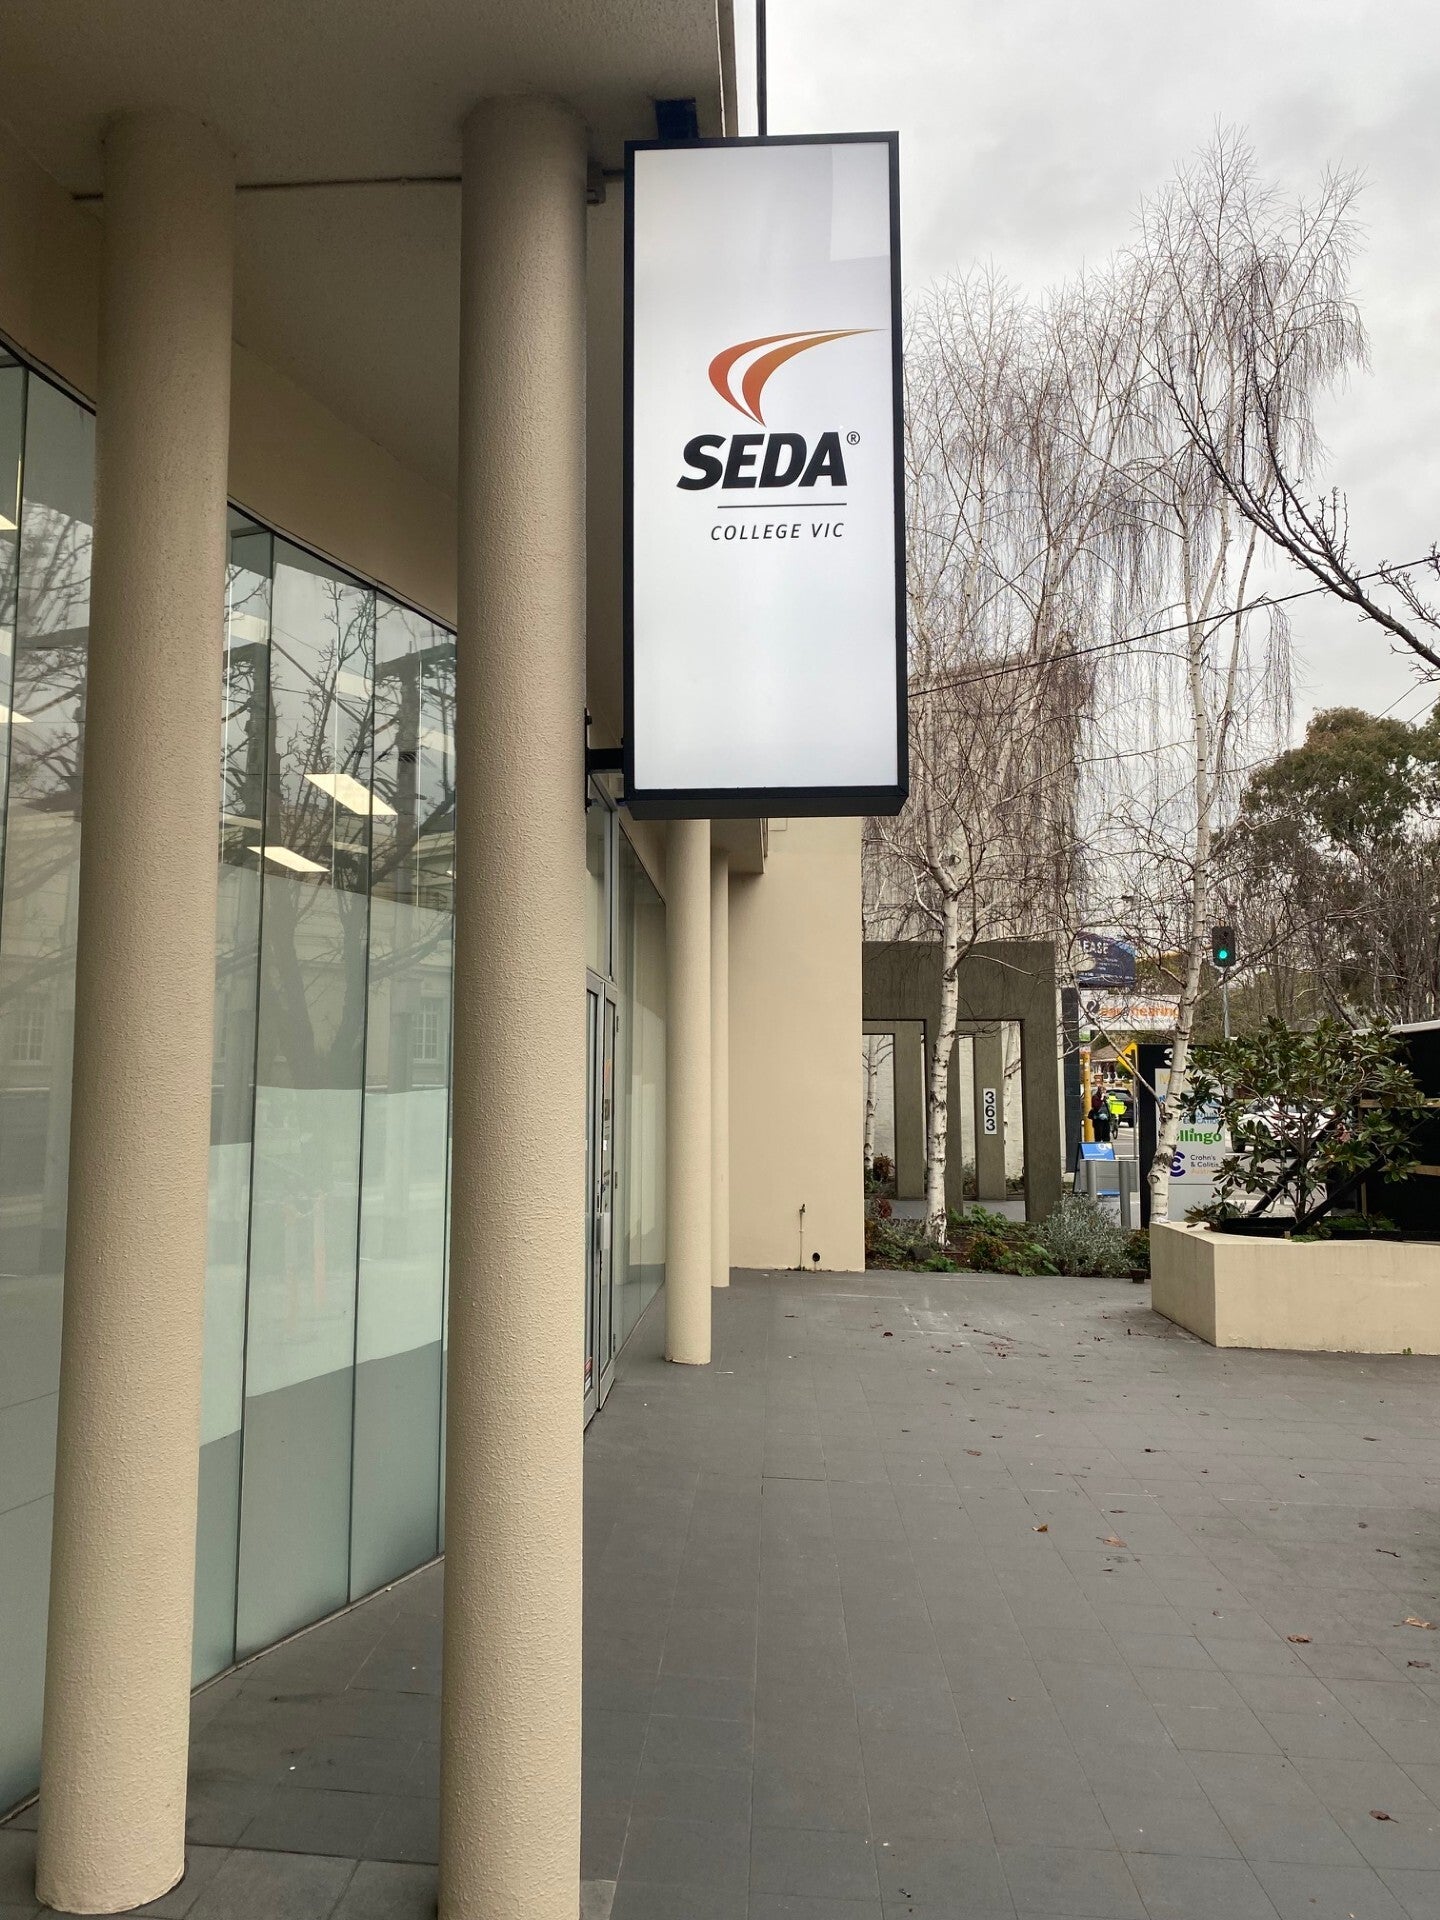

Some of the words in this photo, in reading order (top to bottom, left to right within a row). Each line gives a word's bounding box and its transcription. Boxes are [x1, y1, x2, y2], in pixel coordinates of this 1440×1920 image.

[711, 523, 802, 541] COLLEGE
[811, 522, 845, 538] VIC
[985, 1091, 996, 1132] 363
[1177, 1127, 1223, 1146] llingo
